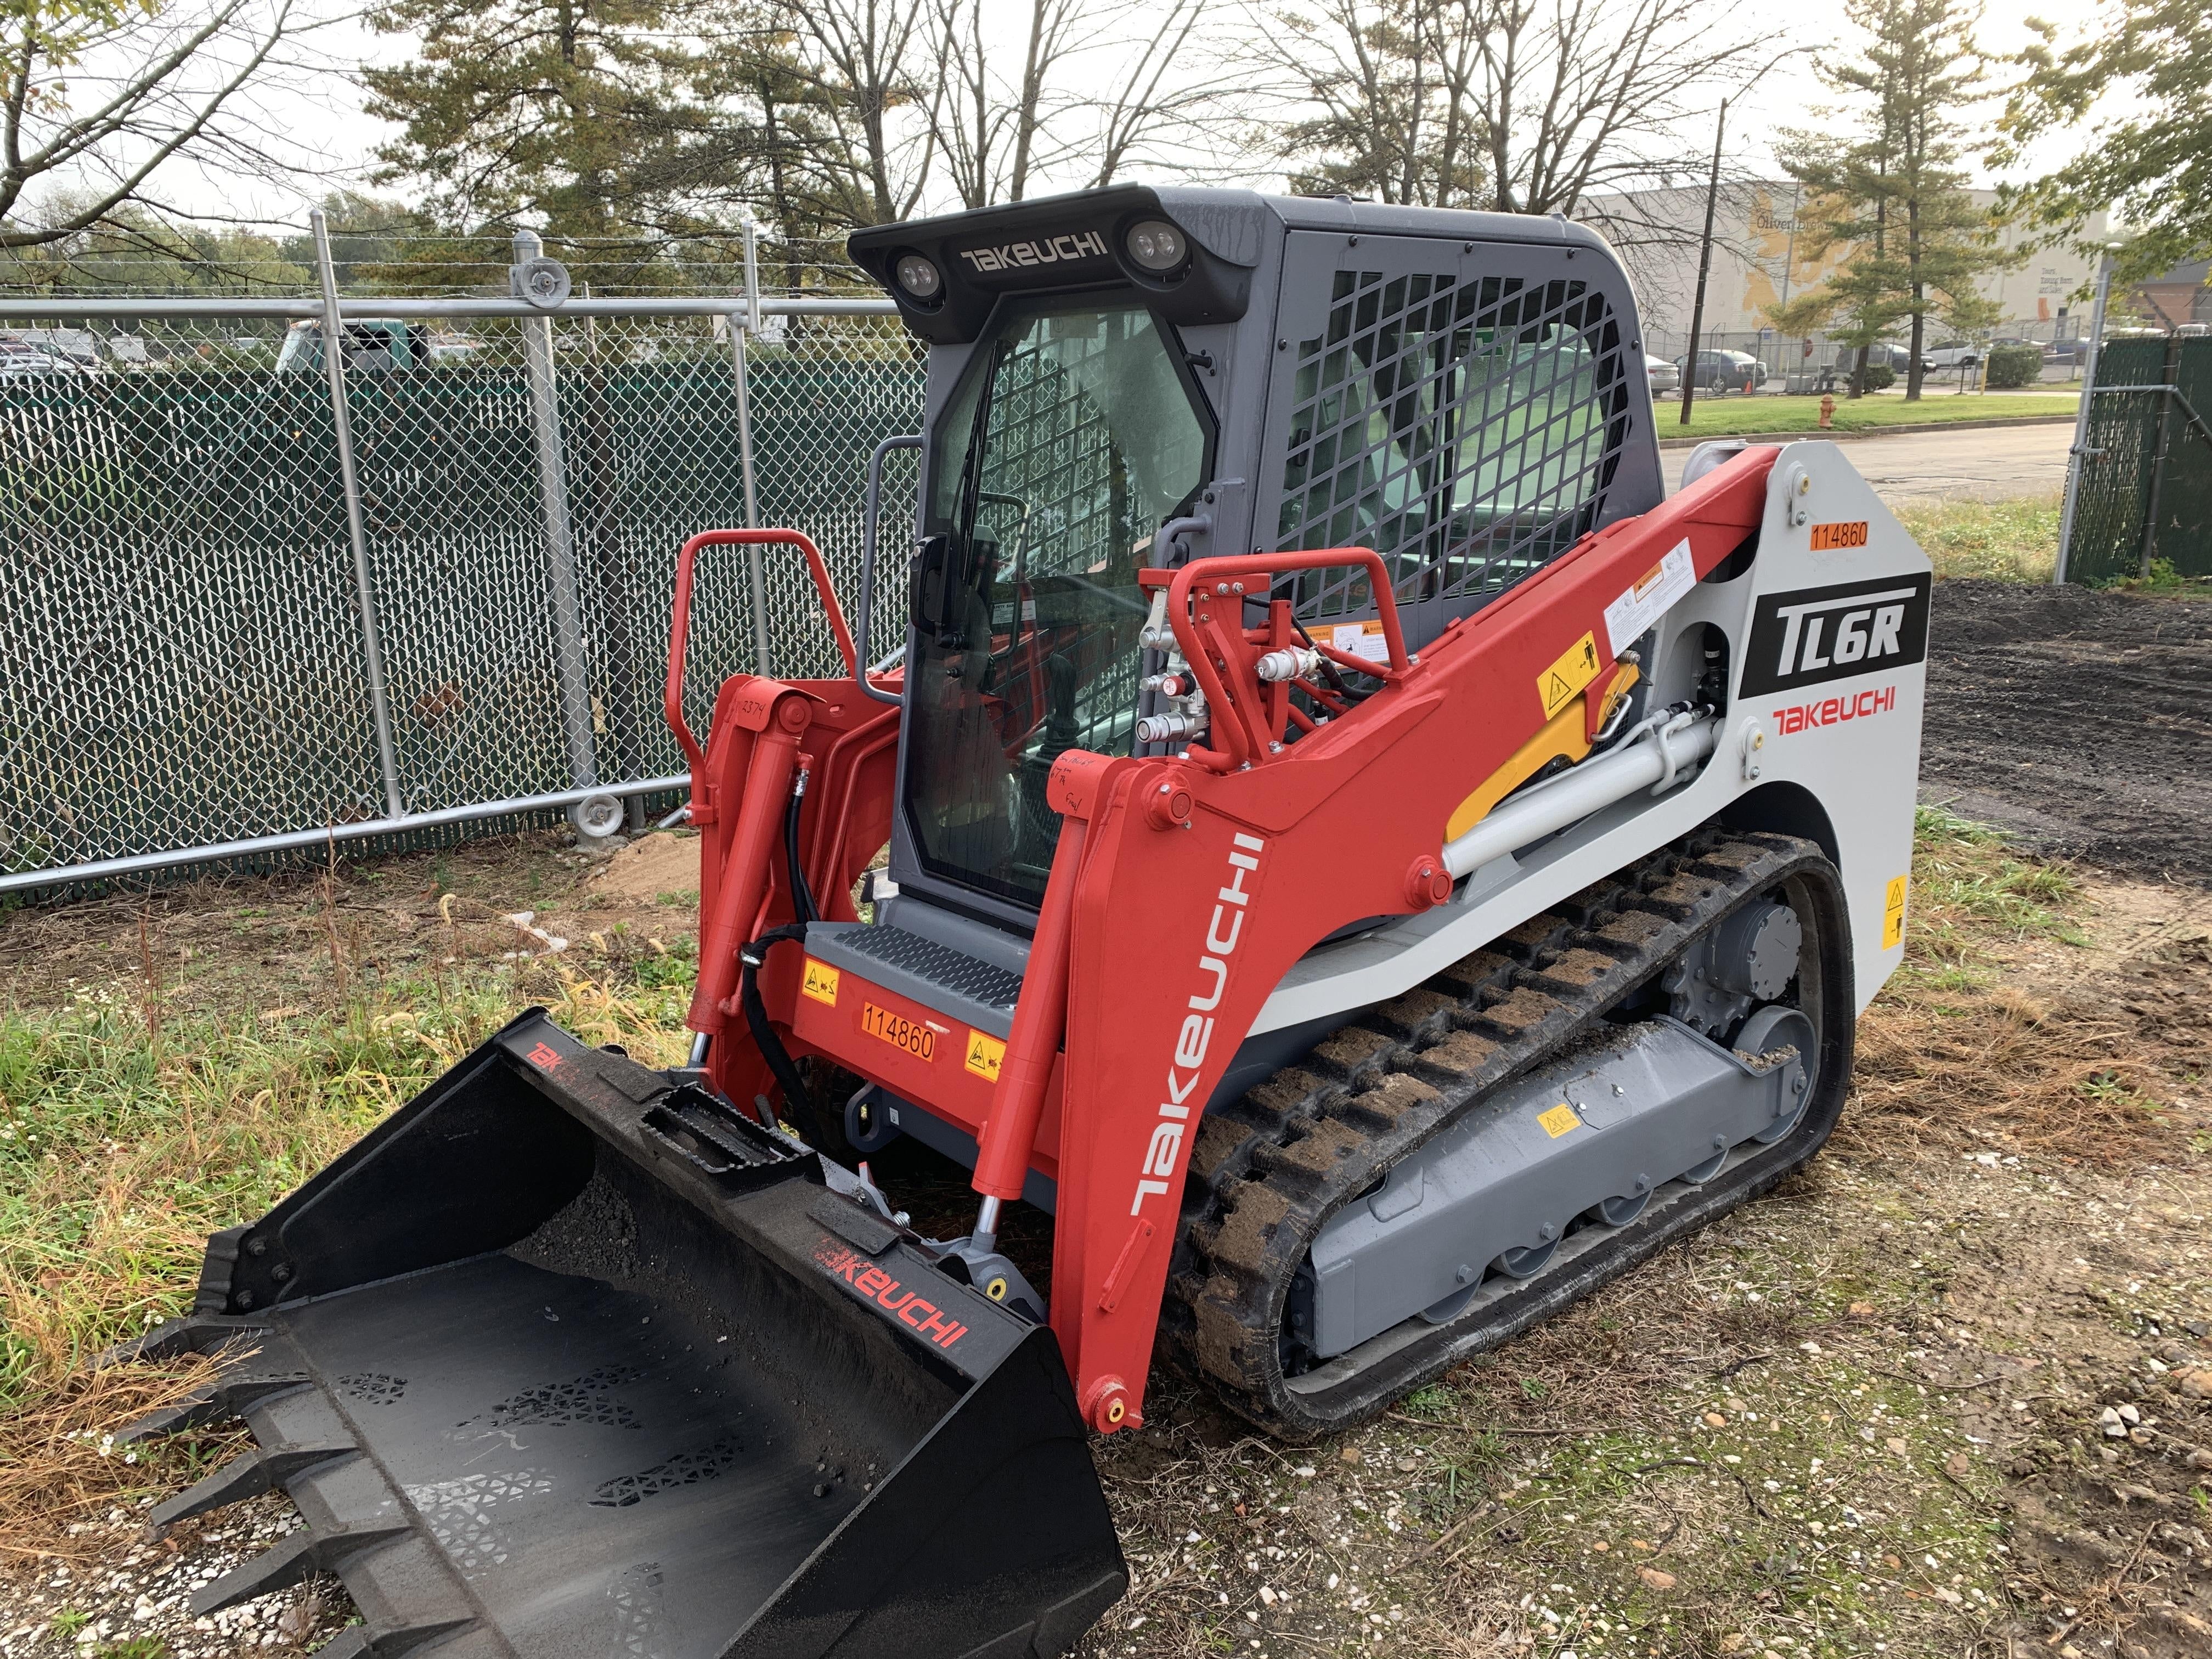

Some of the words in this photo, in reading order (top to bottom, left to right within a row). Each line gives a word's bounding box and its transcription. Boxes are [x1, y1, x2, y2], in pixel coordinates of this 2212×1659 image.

[1757, 215, 1792, 229] Oliver
[960, 231, 1108, 272] TAKEUCHI
[1813, 522, 1867, 549] 114860
[1777, 586, 1917, 676] TL6R
[742, 700, 766, 719] 2374
[1773, 686, 1896, 736] TAKEUCHI
[865, 1005, 934, 1059] 114860
[1130, 832, 1264, 1216] TAKEUCHI
